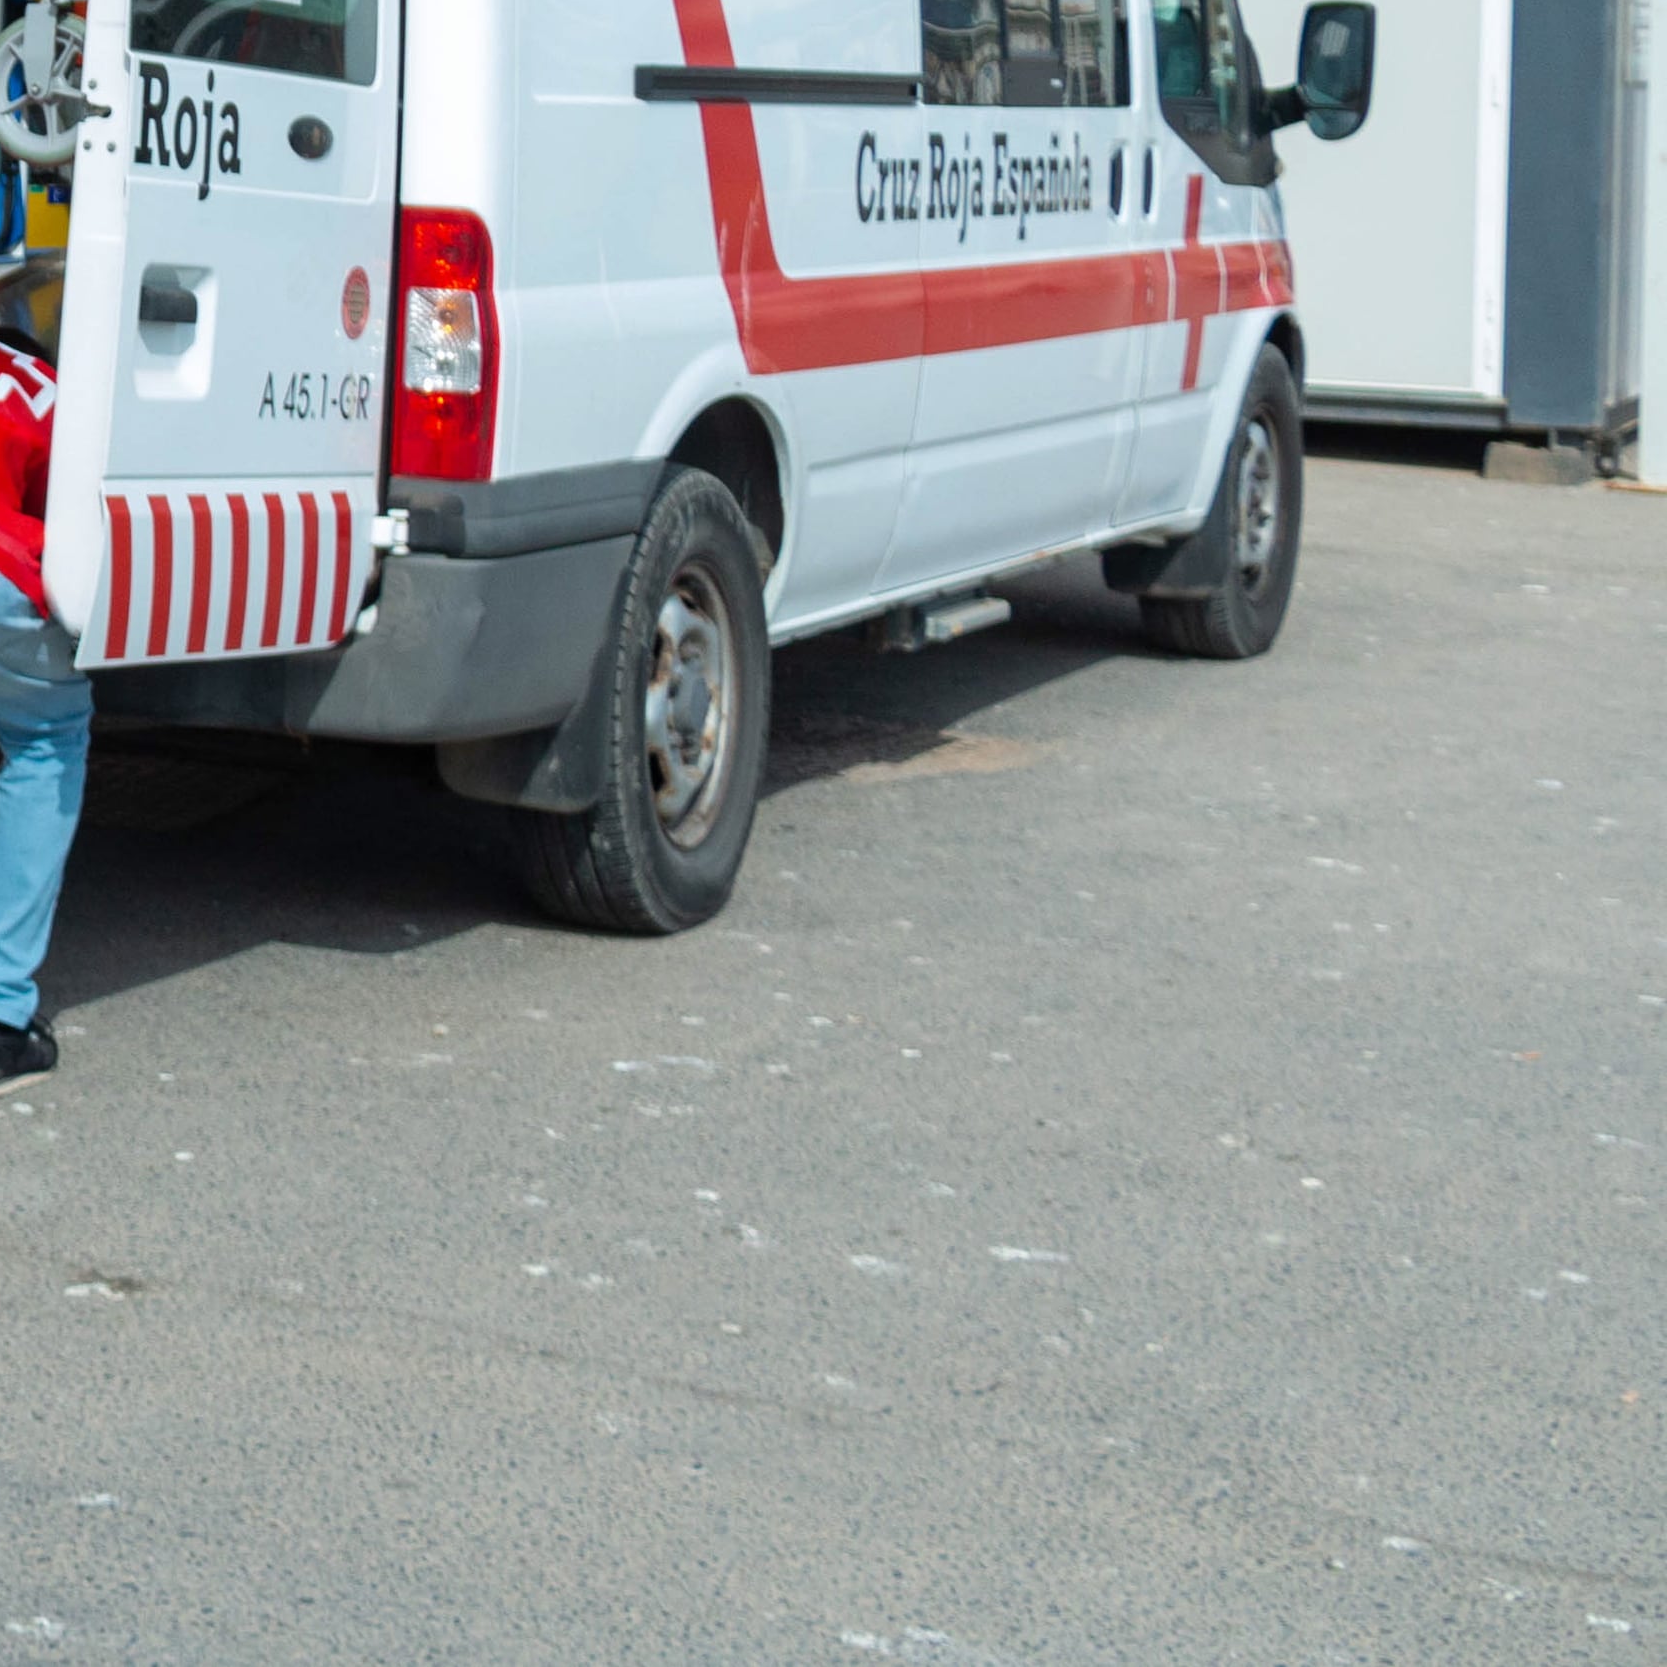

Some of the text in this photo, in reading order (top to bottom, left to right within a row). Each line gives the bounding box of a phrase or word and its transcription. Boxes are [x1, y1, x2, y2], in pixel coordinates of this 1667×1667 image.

[134, 62, 241, 201] Roja
[856, 130, 1091, 243] Cruz Roja Española
[258, 370, 276, 419] A
